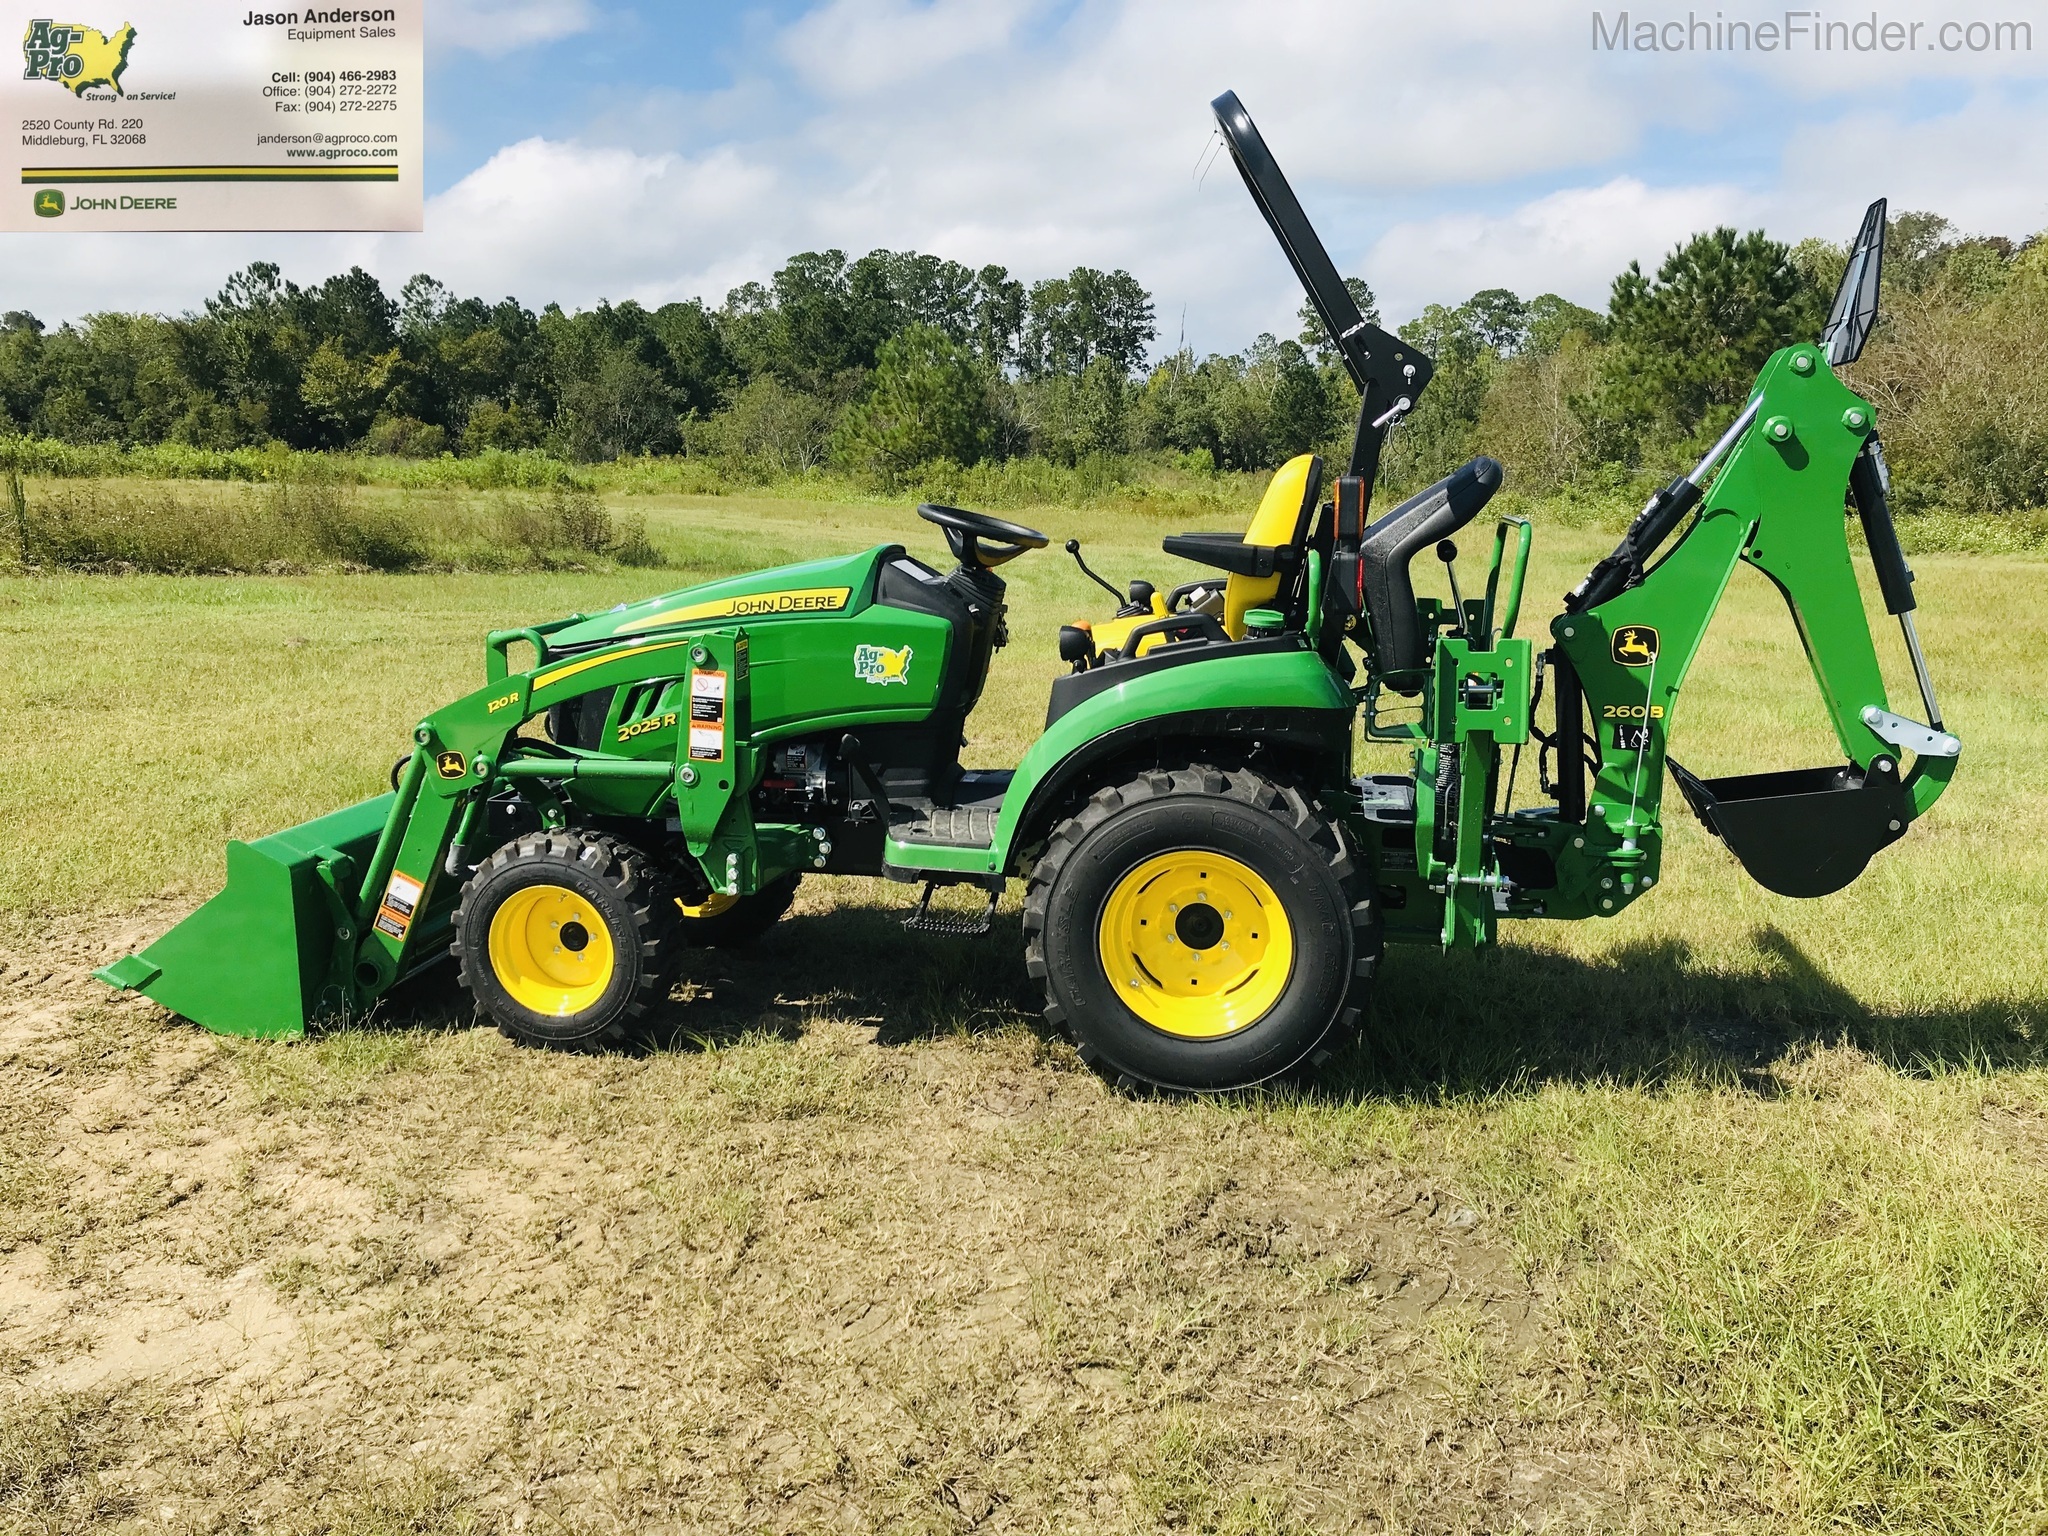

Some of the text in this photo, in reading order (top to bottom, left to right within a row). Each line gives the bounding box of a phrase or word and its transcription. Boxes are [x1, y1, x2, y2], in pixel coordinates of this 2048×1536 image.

[726, 596, 838, 615] JOHN DEERE
[857, 647, 884, 664] Ag-
[858, 661, 885, 675] Pro
[1603, 705, 1664, 718] 260 B
[617, 713, 677, 742] 2025 R
